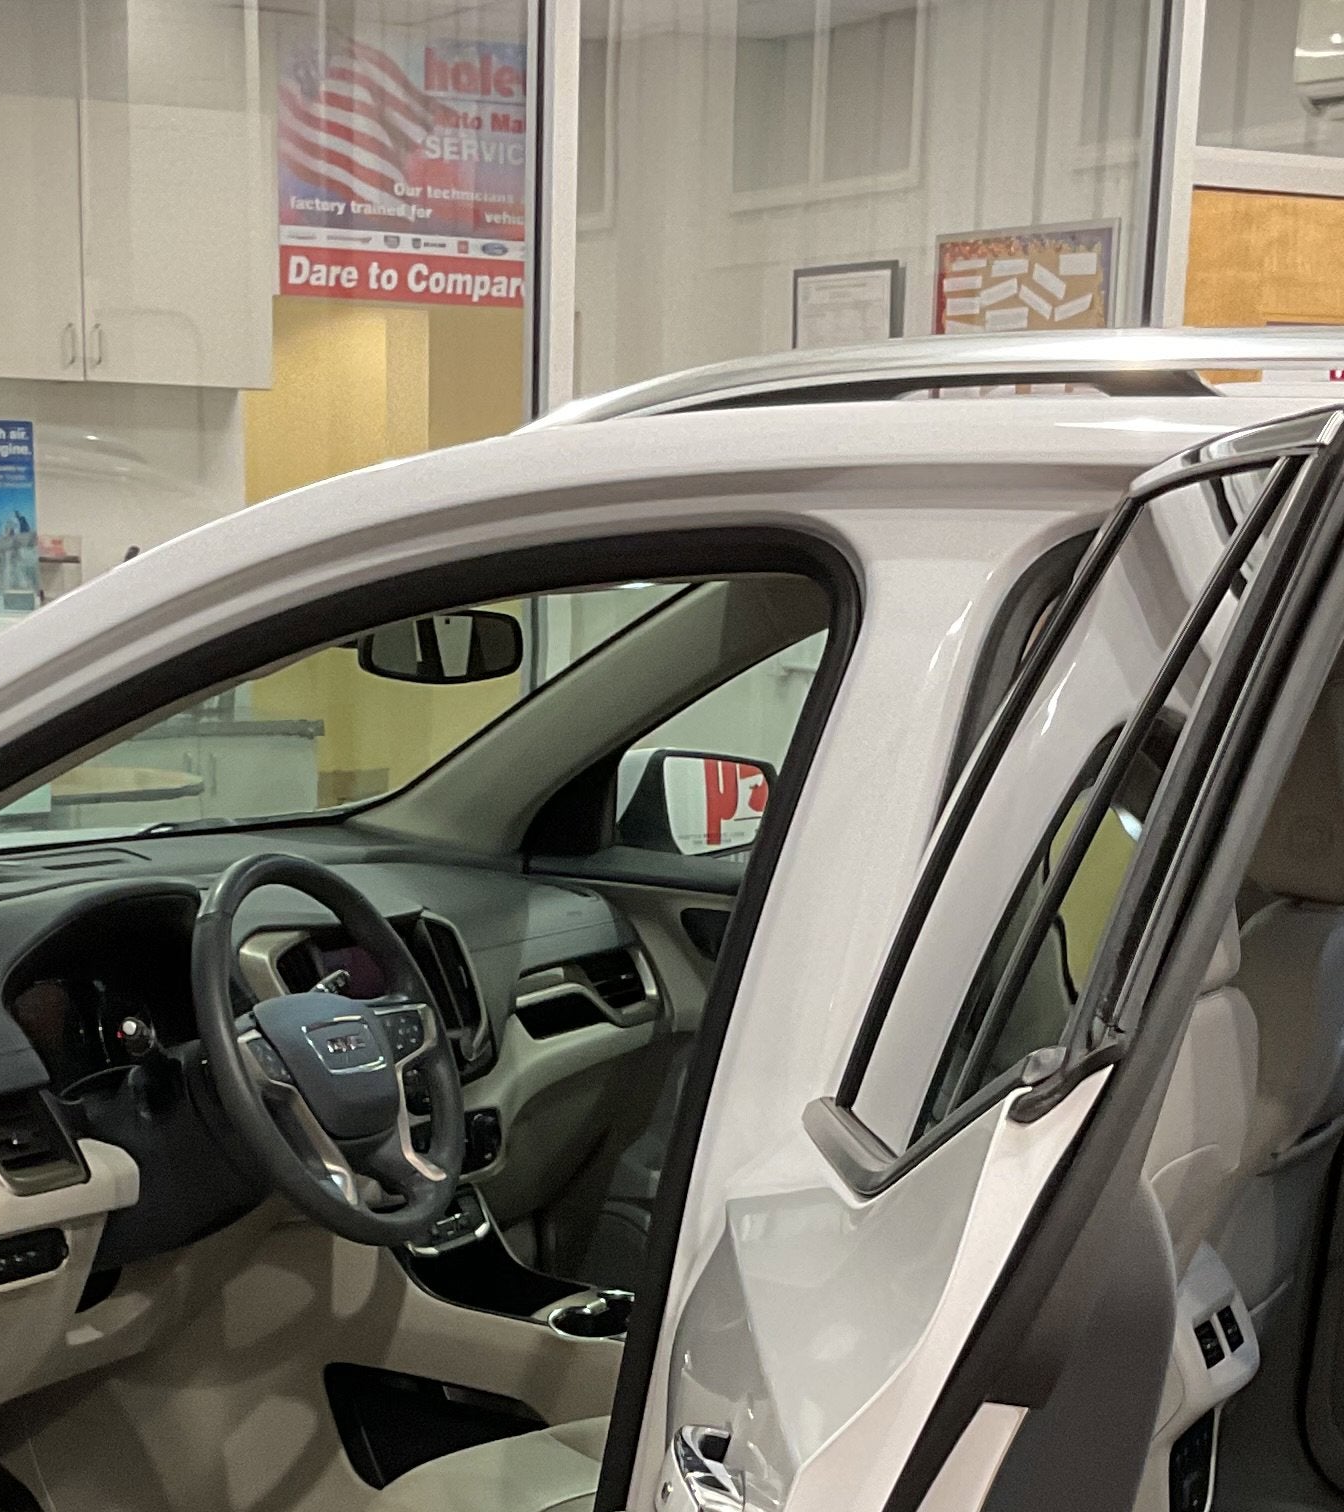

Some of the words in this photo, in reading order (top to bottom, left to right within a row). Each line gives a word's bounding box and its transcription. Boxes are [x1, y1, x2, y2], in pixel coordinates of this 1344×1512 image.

[424, 46, 525, 98] hale
[394, 183, 422, 198] Our
[290, 196, 346, 216] factory
[350, 200, 406, 217] trained
[408, 203, 433, 223] for
[288, 255, 359, 288] Dare
[368, 262, 398, 291] to
